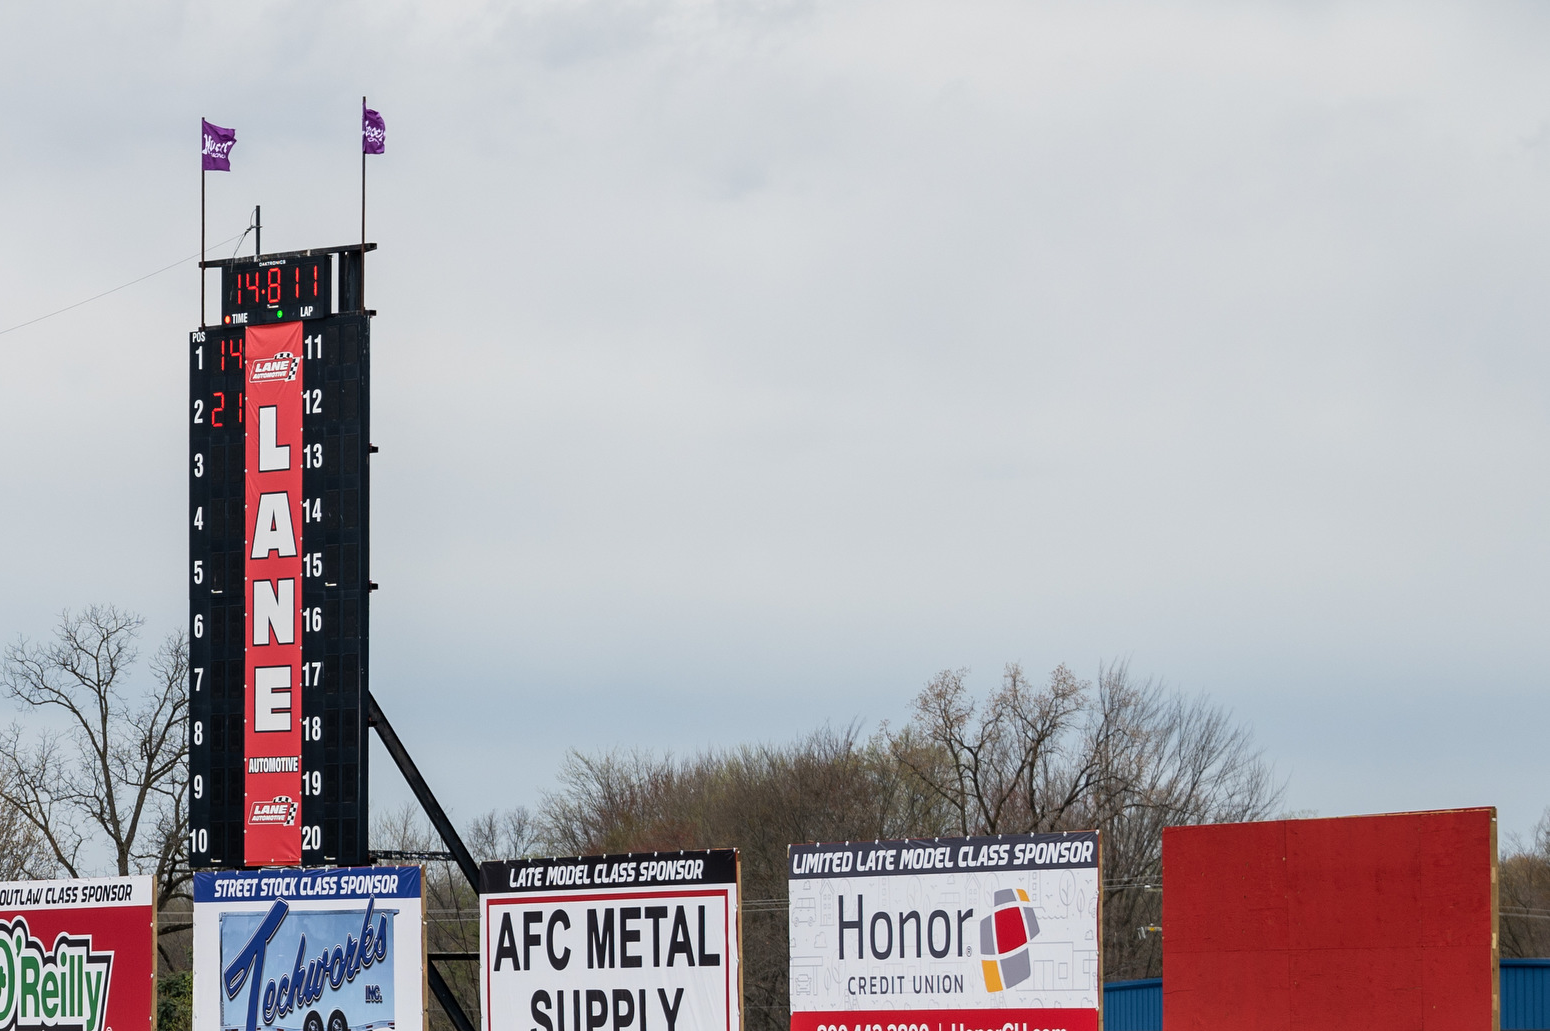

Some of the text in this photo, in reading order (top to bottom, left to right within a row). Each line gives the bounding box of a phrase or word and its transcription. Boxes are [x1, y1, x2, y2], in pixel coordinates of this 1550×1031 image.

[232, 313, 248, 324] TIME
[300, 306, 313, 317] LAP
[192, 332, 206, 343] POS
[304, 334, 322, 360] 11
[195, 346, 203, 370] 1
[221, 339, 243, 371] 14
[254, 361, 289, 373] LANE
[252, 370, 287, 379] AUTOMOTIVE
[194, 399, 204, 424] 2
[211, 392, 243, 427] 21
[302, 389, 323, 415] 12
[194, 453, 204, 478] 3
[303, 443, 323, 469] 13
[194, 506, 204, 530] 4
[302, 498, 322, 523] 14
[194, 560, 203, 584] 5
[302, 552, 323, 577] 15
[194, 614, 204, 639] 6
[302, 607, 322, 632] 16
[194, 668, 204, 692] 7
[302, 661, 322, 687] 17
[194, 721, 203, 746] 8
[302, 716, 322, 741] 18
[248, 756, 299, 773] AUTOMOTIVE
[194, 774, 203, 799] 9
[302, 771, 322, 796] 19
[254, 804, 288, 815] LANE
[189, 829, 208, 853] 10
[301, 825, 321, 850] 20
[792, 840, 1094, 875] LIMITED LATE MODEL CLASS SPONSOR
[214, 874, 399, 898] STREET STOCK CLASS SPONSOR
[509, 859, 704, 888] LATE MODEL CLASS SPONSOR
[0, 887, 43, 906] OUTLAW
[45, 886, 79, 905] CLASS
[81, 884, 133, 903] SPONSOR
[493, 905, 721, 972] AFC METAL
[838, 894, 974, 960] Honor
[365, 985, 383, 1002] INC.
[847, 974, 964, 996] CREDIT UNION
